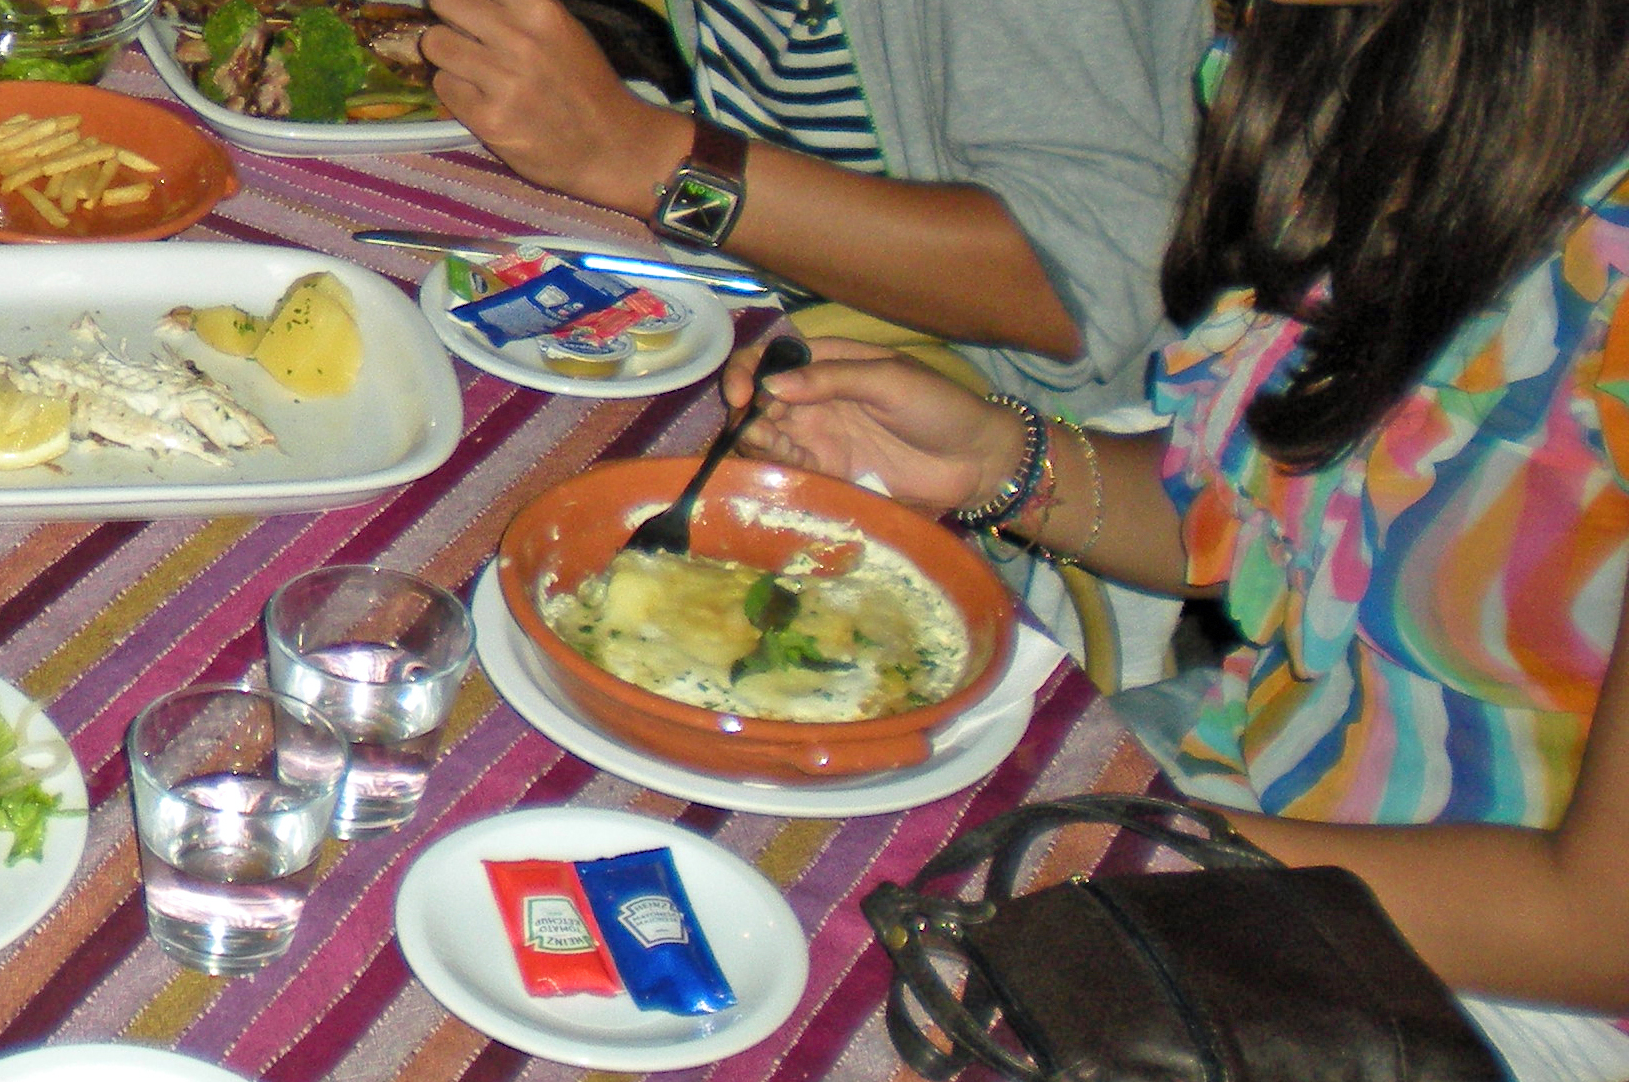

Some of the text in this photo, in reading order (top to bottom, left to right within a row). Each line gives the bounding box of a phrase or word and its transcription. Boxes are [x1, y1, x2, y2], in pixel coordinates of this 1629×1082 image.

[535, 917, 580, 927] KETCHUP
[539, 924, 581, 934] TOMATO
[547, 936, 583, 947] HEINZ
